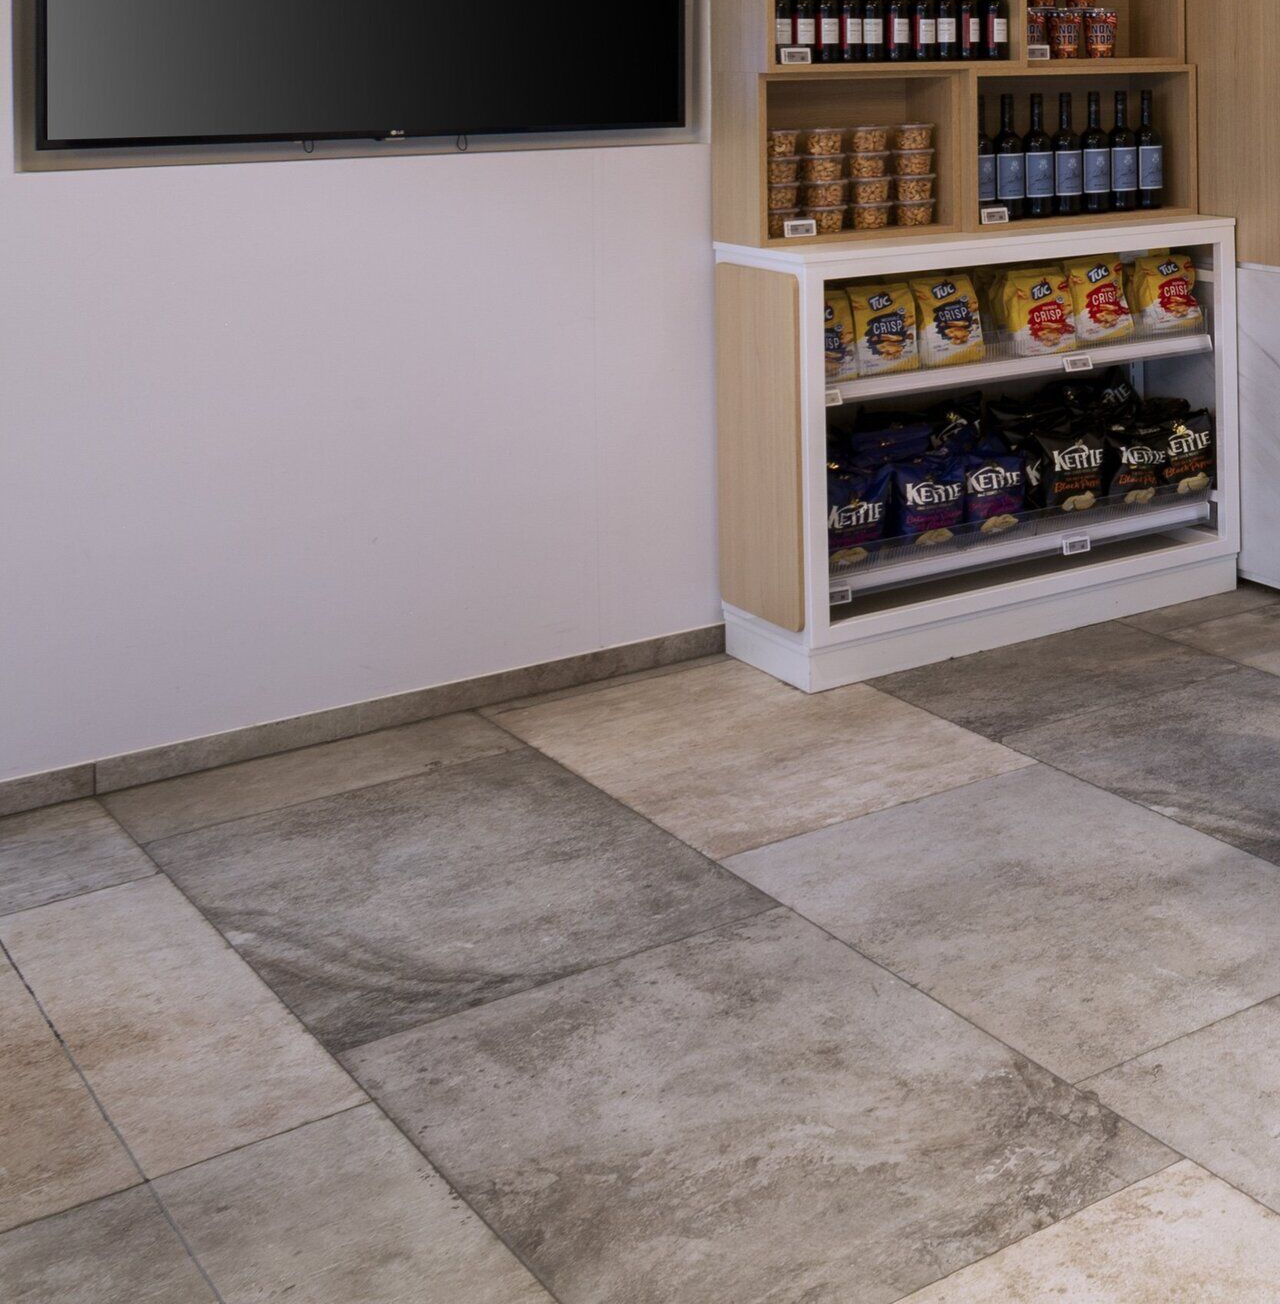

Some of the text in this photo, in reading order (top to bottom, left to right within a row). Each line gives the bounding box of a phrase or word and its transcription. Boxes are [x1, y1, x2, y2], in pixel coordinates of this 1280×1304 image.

[938, 306, 968, 321] CRISP
[1033, 309, 1062, 323] CRISP
[872, 319, 903, 335] CRISP
[1052, 444, 1104, 472] KETTLE
[1119, 445, 1167, 466] KETTLE
[967, 466, 1022, 494] KETTLE
[905, 481, 962, 507] KETTLE
[827, 501, 883, 529] KETTLE
